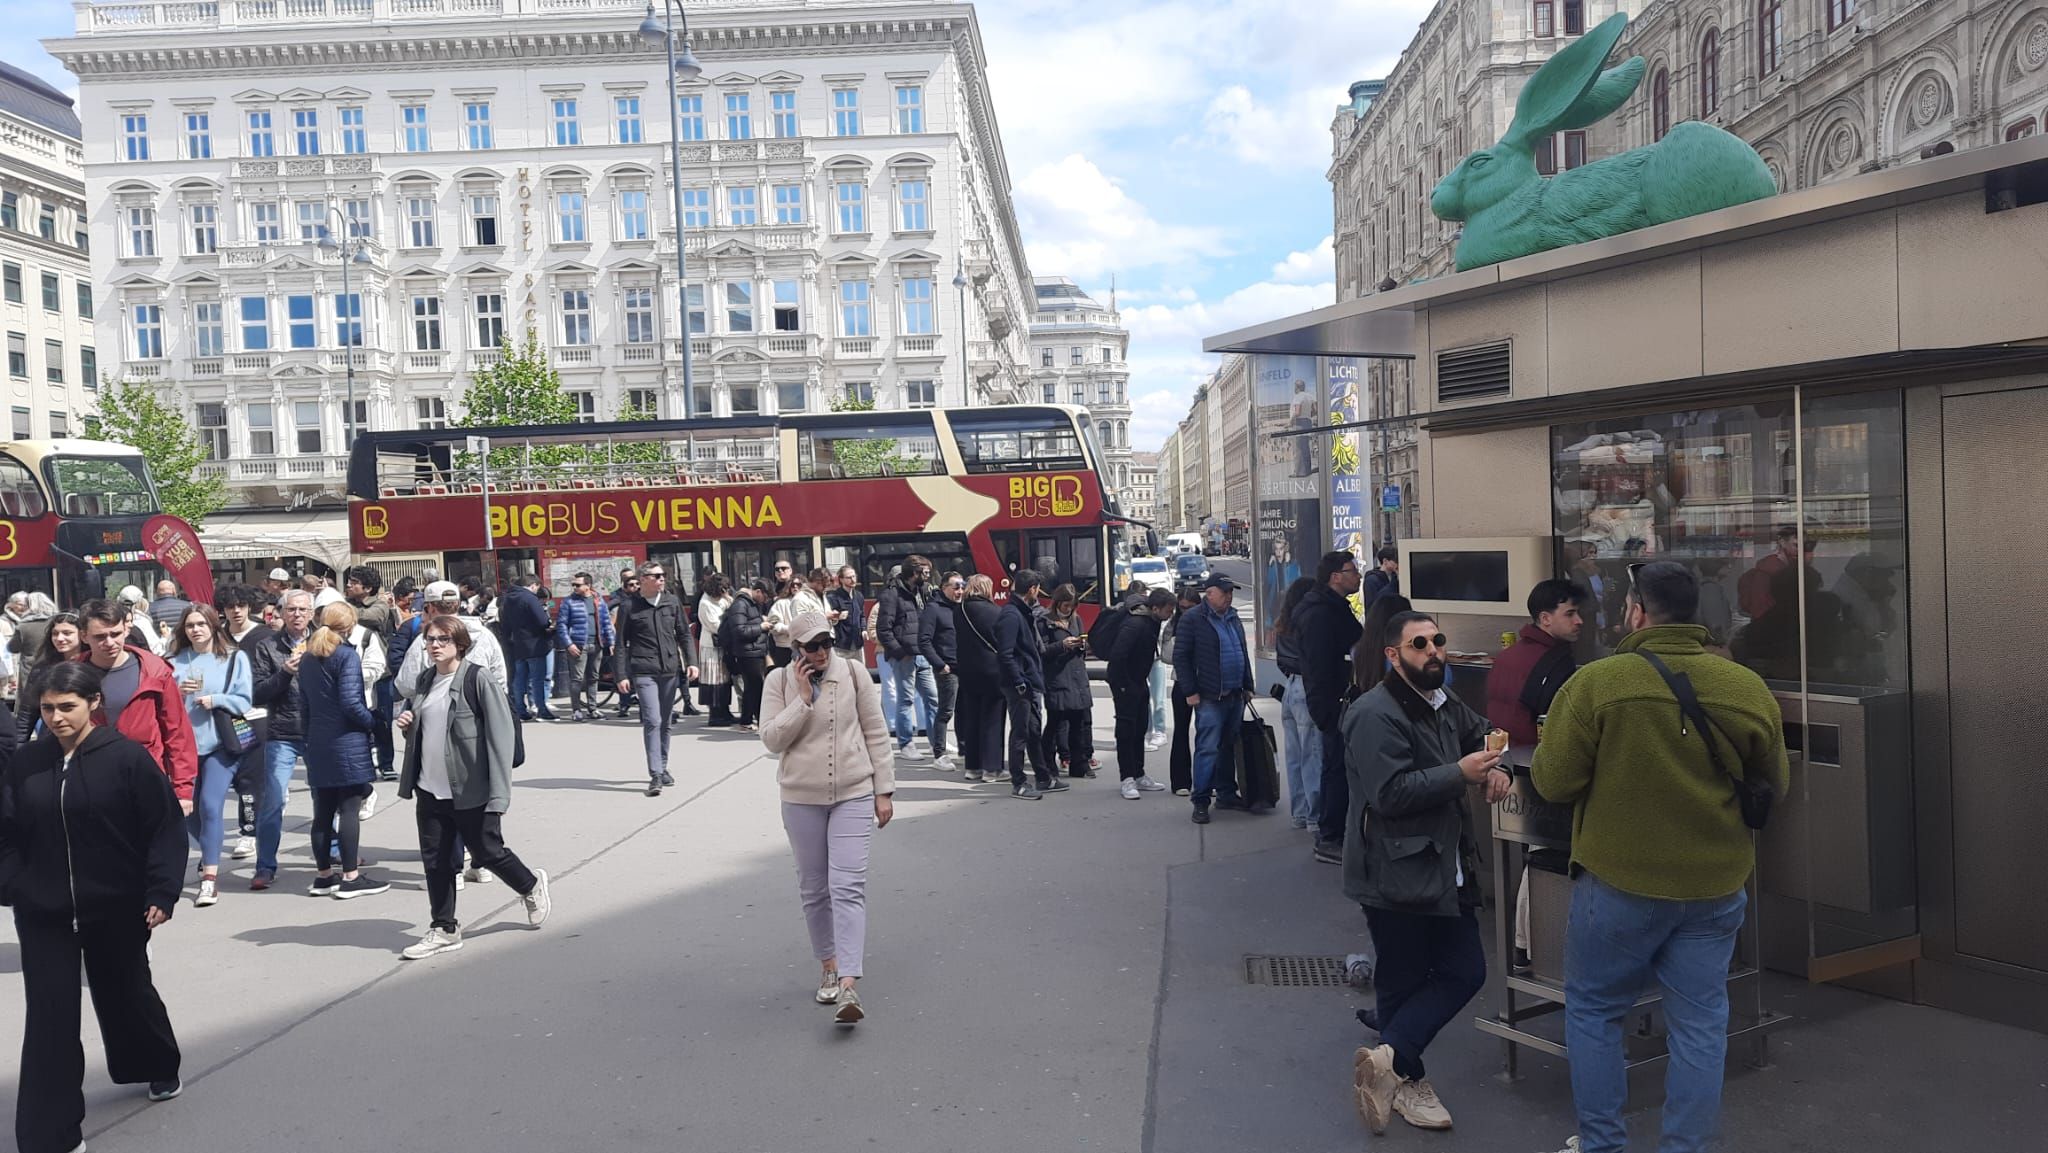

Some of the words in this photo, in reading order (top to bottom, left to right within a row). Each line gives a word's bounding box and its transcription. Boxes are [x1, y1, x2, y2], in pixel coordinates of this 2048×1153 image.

[517, 167, 533, 252] HOTEL
[1009, 476, 1050, 498] BIG
[630, 495, 783, 532] VIENNA
[1010, 498, 1051, 518] BUS
[1332, 505, 1351, 516] ROY
